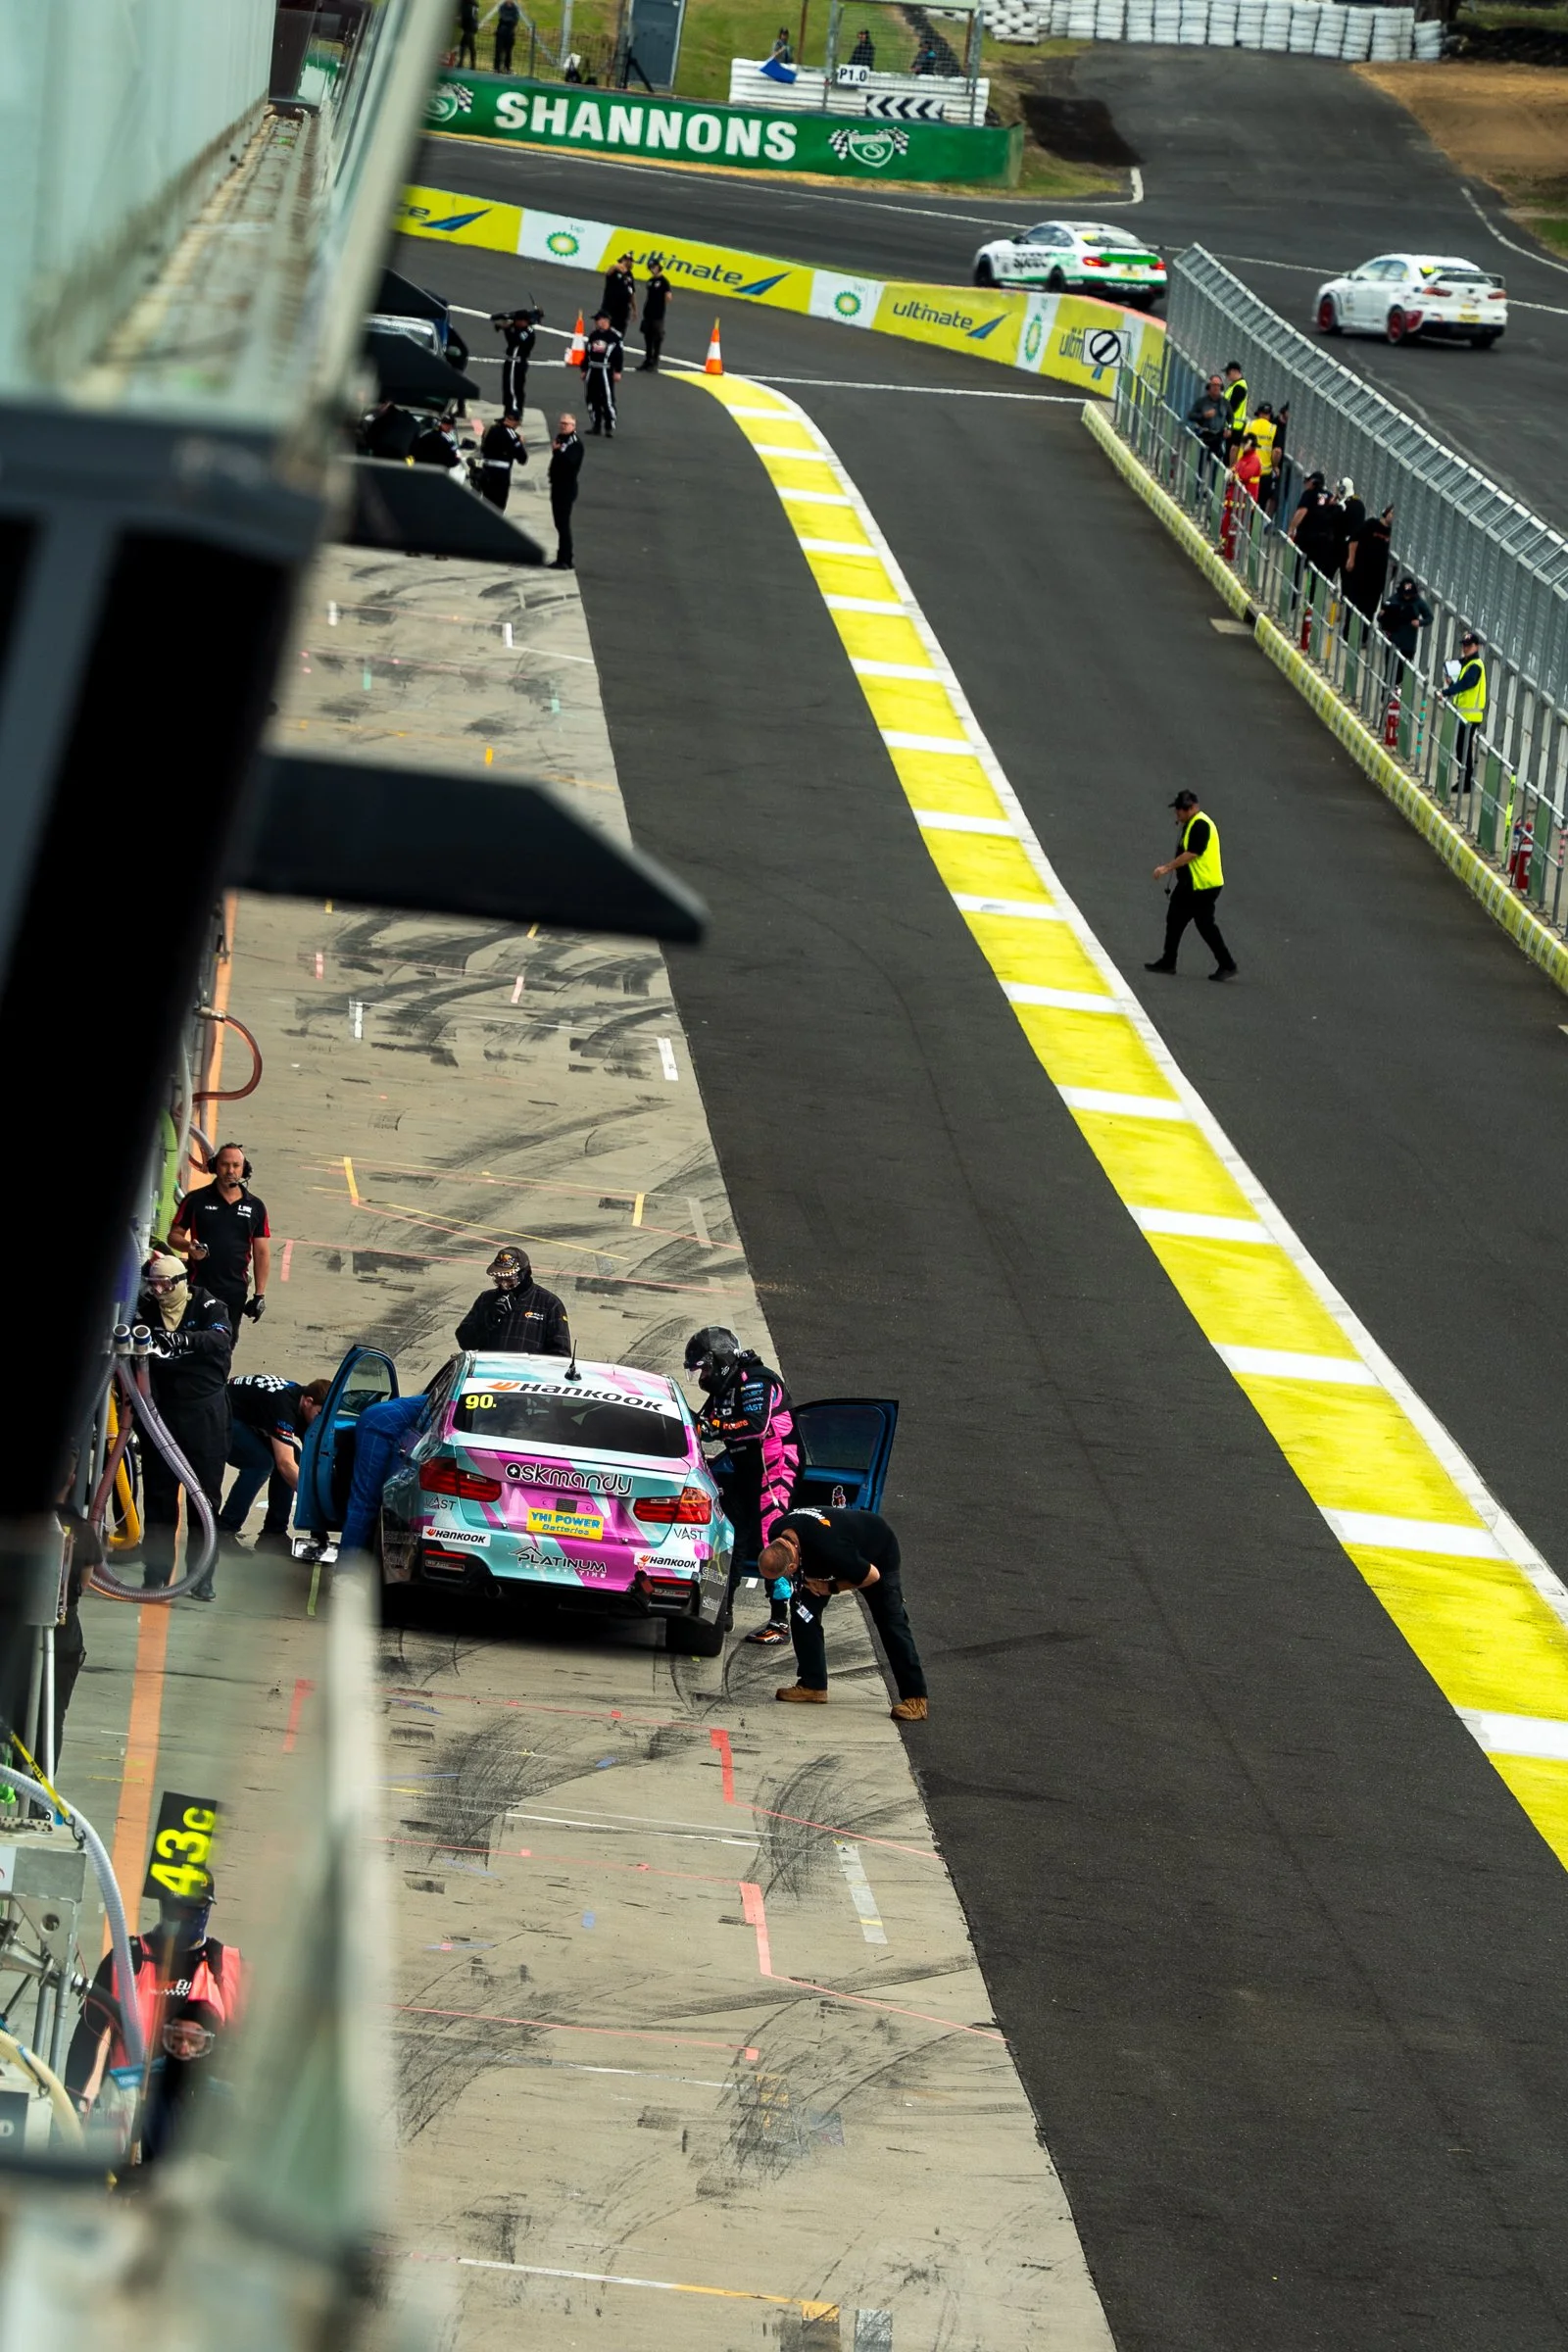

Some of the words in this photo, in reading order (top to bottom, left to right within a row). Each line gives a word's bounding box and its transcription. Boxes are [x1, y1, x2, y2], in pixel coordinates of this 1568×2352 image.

[839, 67, 867, 82] P1.0
[494, 91, 798, 162] SHANNONS
[893, 301, 973, 330] ultimate
[506, 1462, 633, 1494] askmandy
[424, 1495, 457, 1510] VAST
[531, 1511, 552, 1522] YHI
[555, 1515, 601, 1529] POWER
[542, 1524, 590, 1535] Batteries
[673, 1527, 703, 1540] VAST
[517, 1553, 607, 1573] PLATINUM
